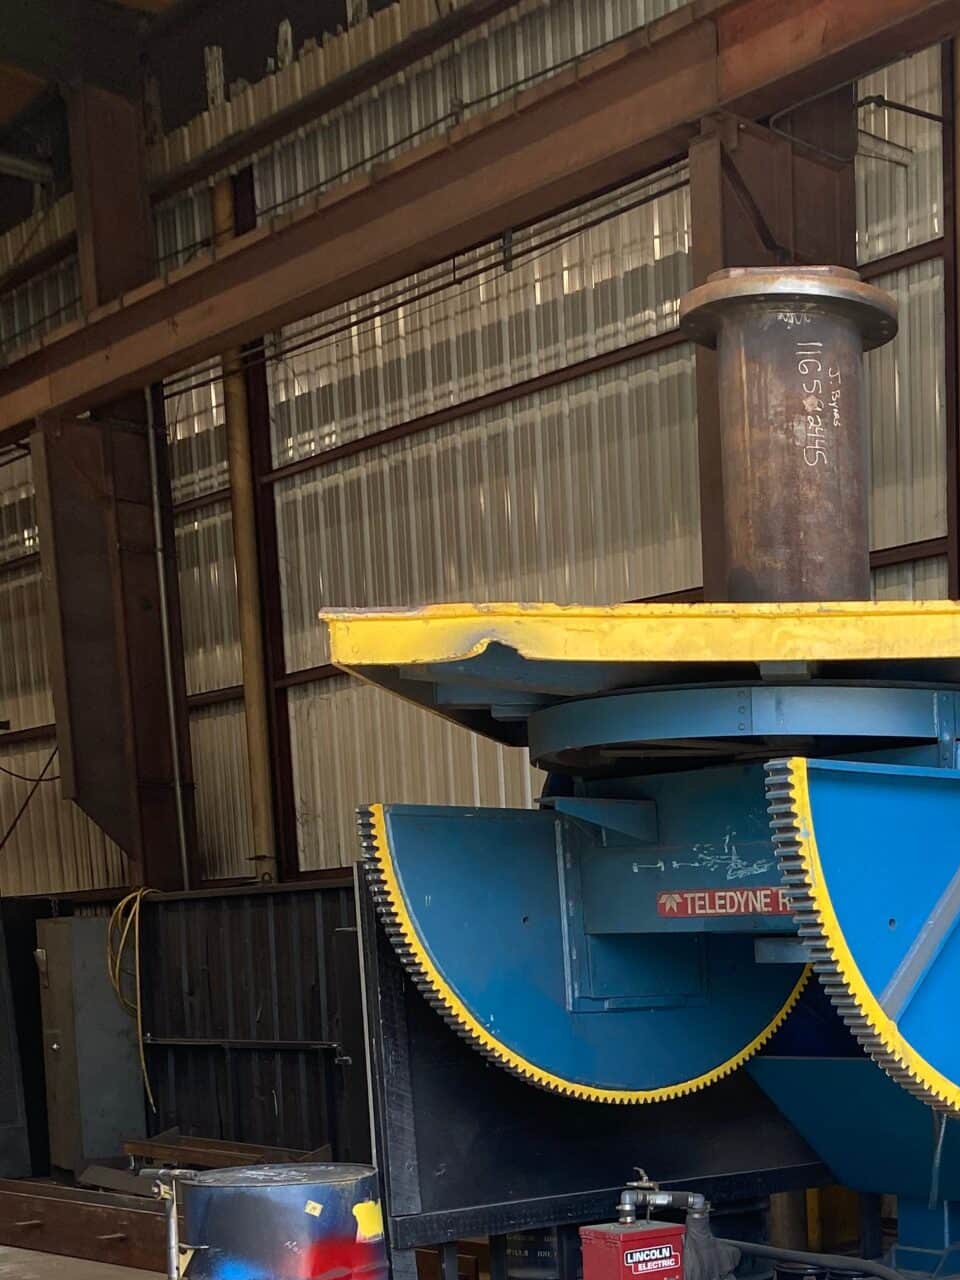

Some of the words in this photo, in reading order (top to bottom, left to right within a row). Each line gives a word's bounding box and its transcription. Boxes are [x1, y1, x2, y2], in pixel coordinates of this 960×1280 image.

[684, 889, 772, 915] TELEDYNE
[627, 1247, 670, 1264] LINCOLN
[637, 1258, 675, 1272] ELECTRIC
